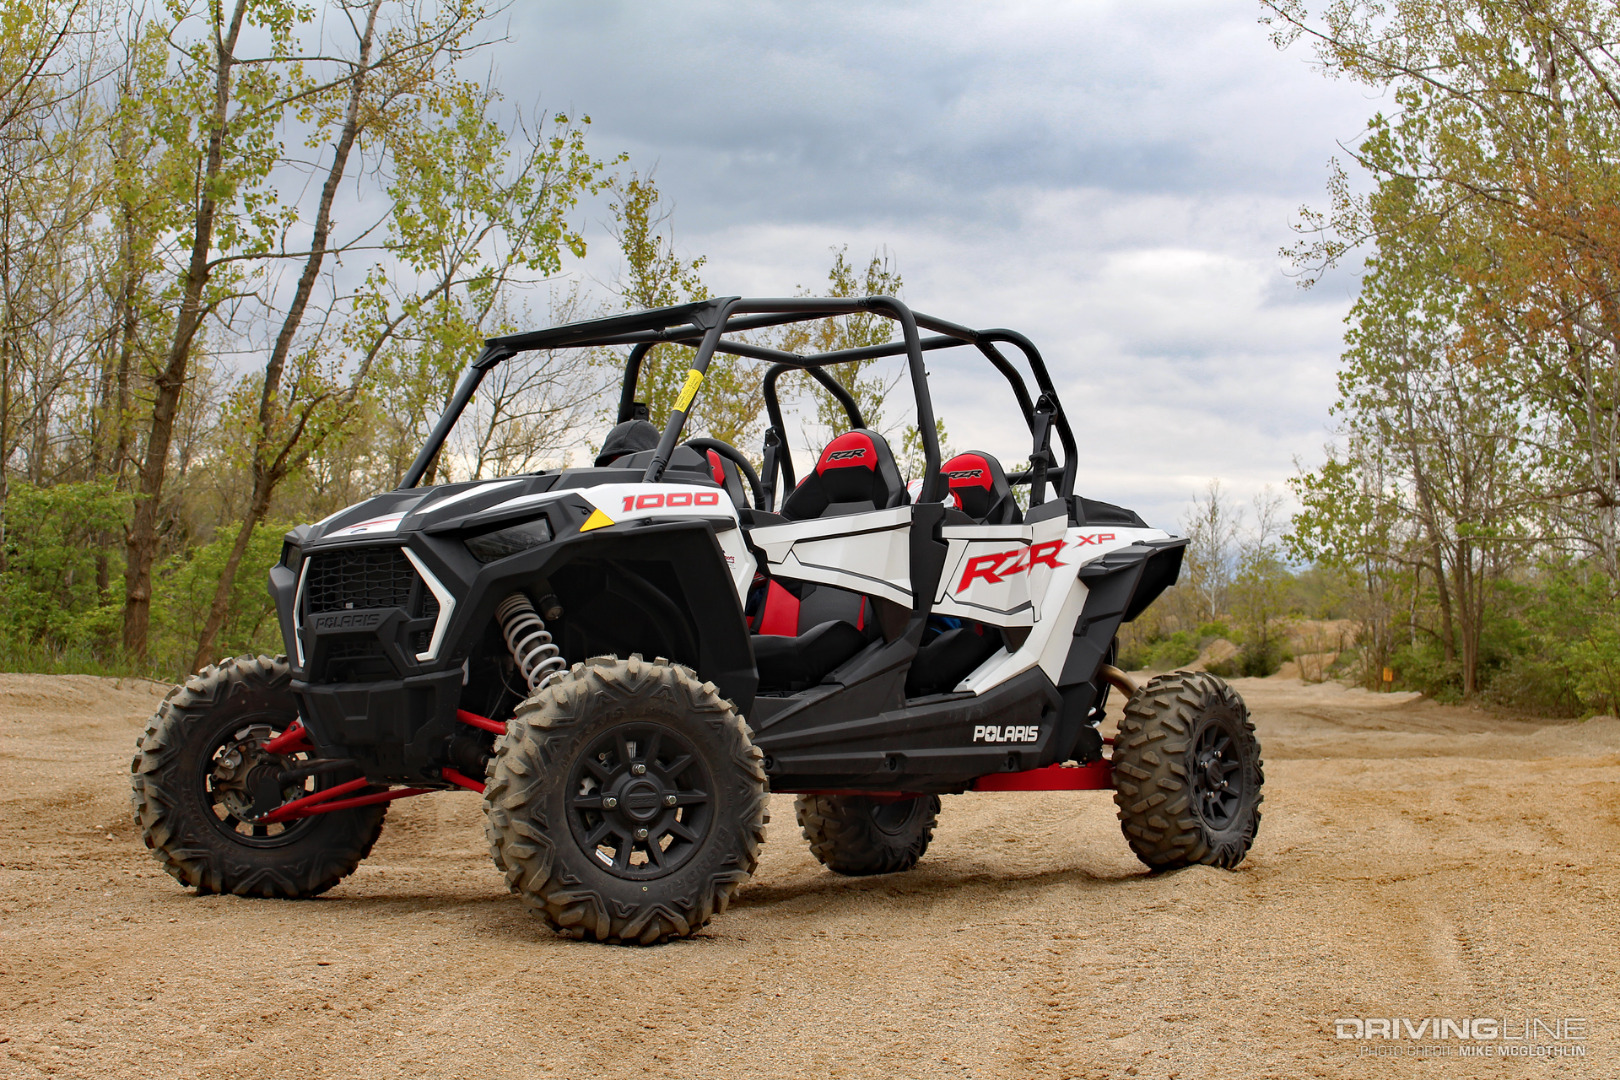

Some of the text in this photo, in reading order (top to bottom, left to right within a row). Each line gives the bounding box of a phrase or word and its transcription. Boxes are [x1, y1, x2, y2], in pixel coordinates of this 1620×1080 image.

[826, 447, 867, 463] RZR
[948, 469, 984, 480] RZR
[622, 492, 719, 513] 1000
[954, 533, 1116, 596] RZR XP
[315, 613, 380, 629] POLARIS
[973, 725, 1039, 742] POLARIS
